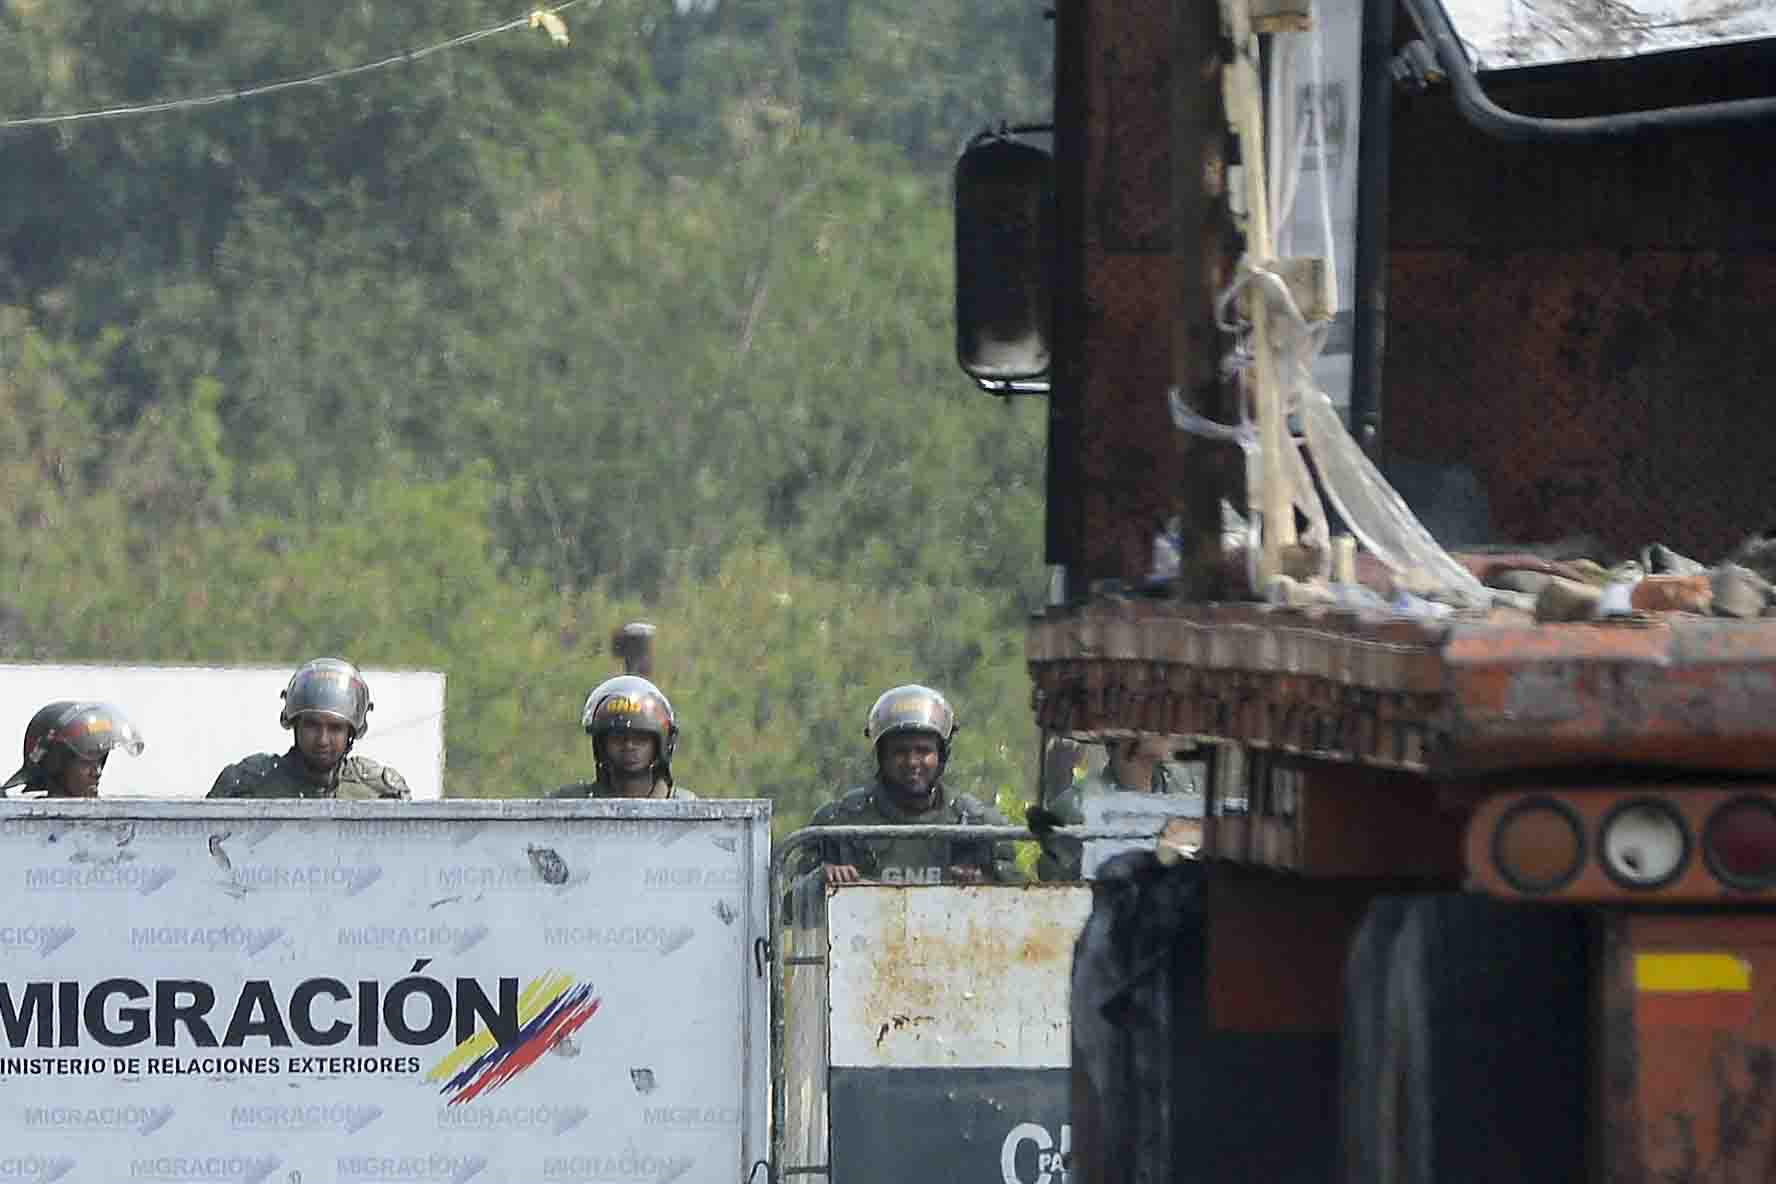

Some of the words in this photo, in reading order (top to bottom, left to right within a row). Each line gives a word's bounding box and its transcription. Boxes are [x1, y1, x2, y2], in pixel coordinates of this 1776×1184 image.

[113, 1057, 141, 1075] DE
[147, 1057, 280, 1075] RELACIONES
[287, 1056, 421, 1074] EXTERIORES
